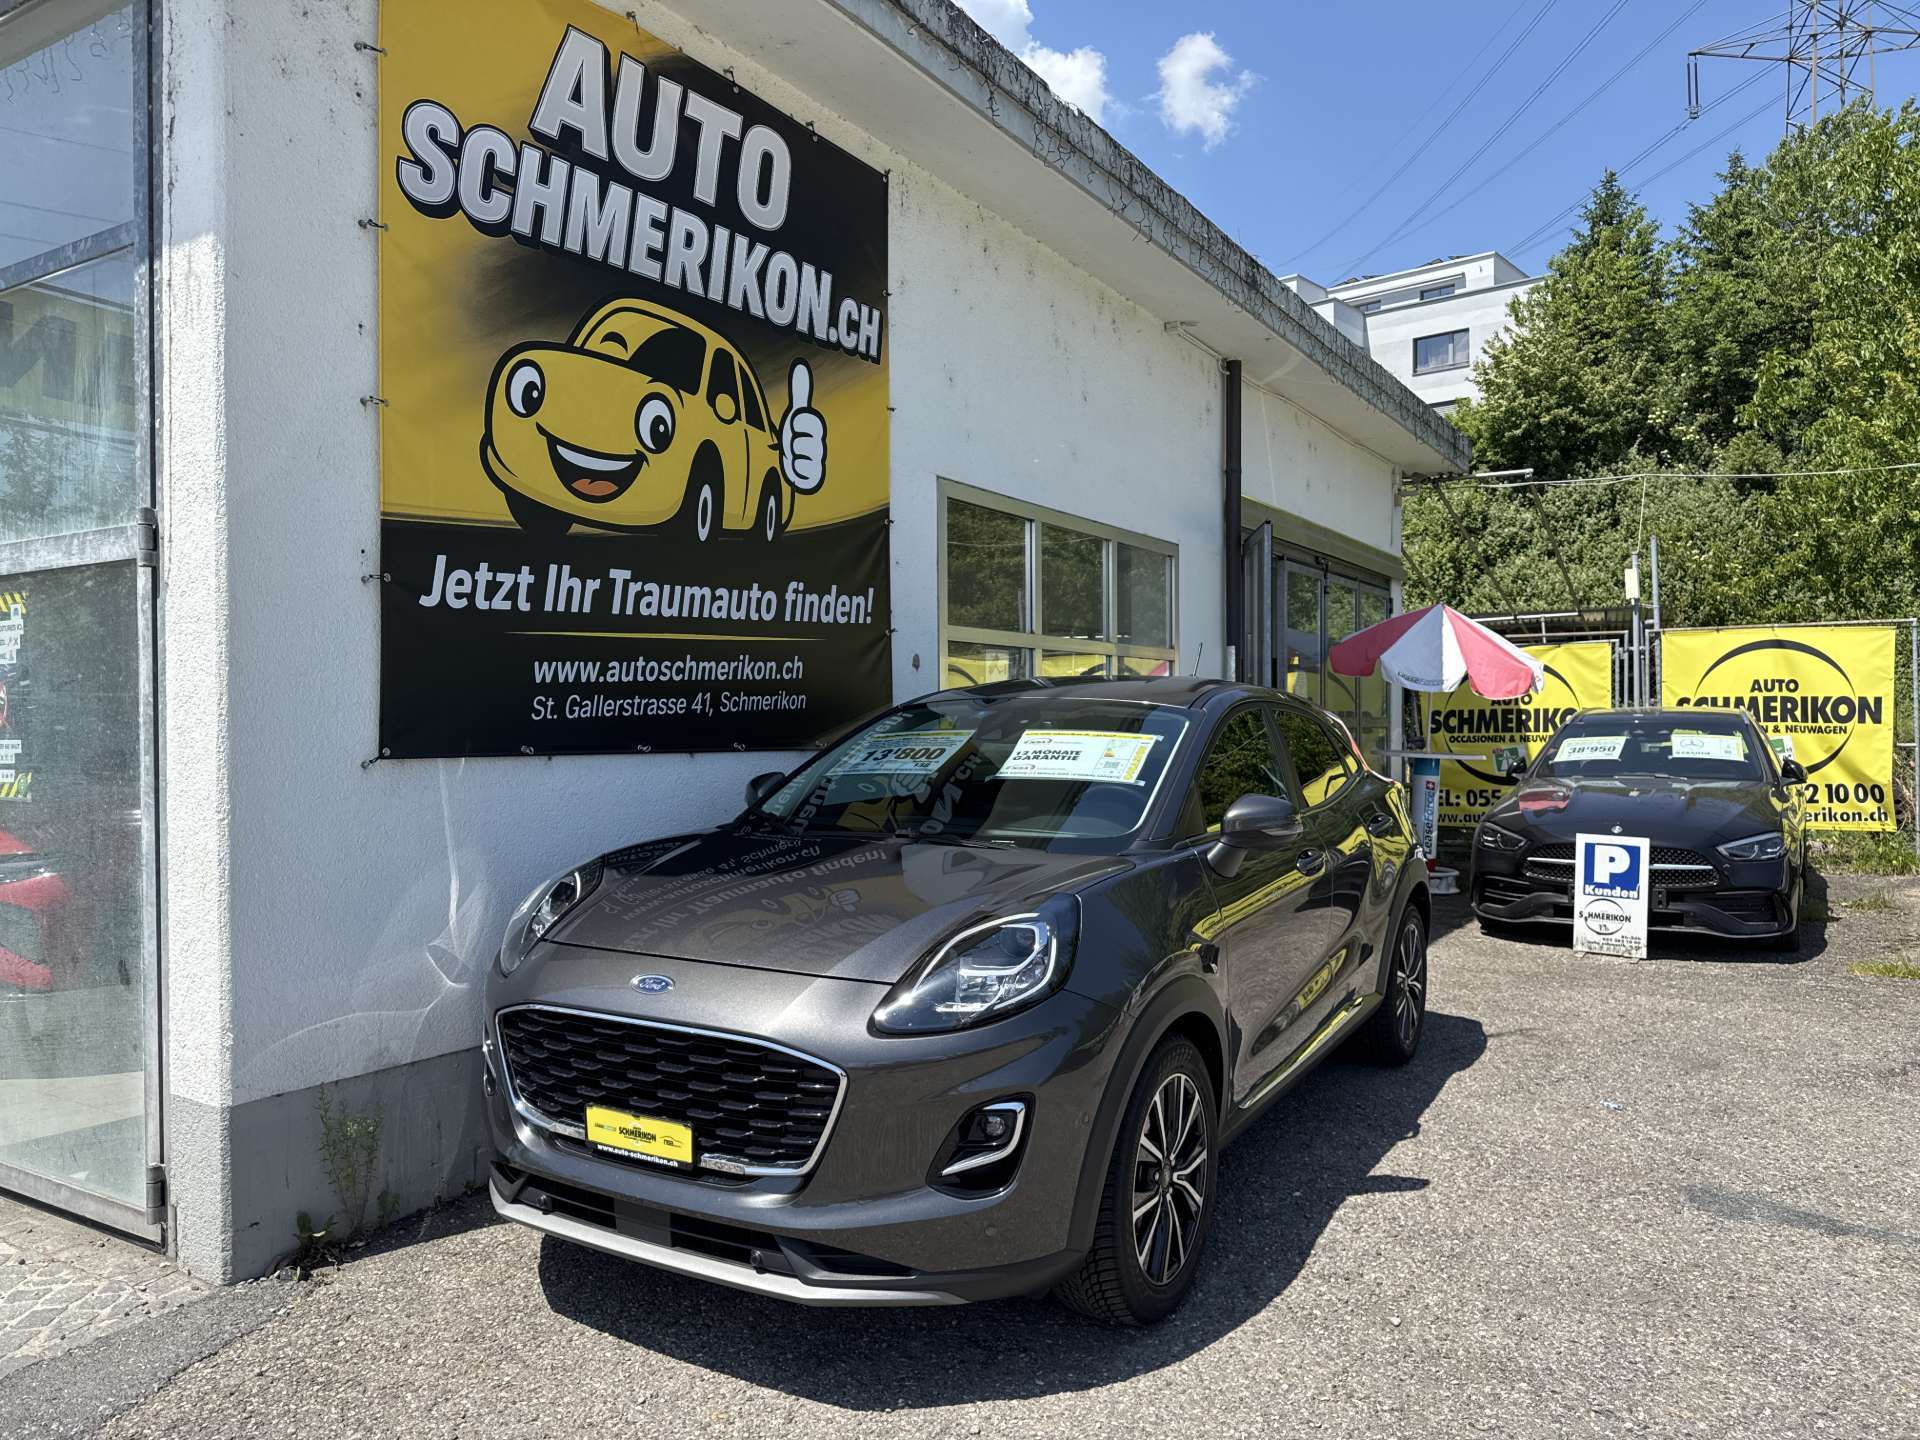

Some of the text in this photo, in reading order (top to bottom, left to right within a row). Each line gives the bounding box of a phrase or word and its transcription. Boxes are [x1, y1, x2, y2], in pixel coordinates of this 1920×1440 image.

[529, 27, 792, 231] AUTO
[398, 101, 882, 361] SCHMERIKON.CH
[418, 554, 873, 624] Jetzt Ihr Traumauto finden!
[533, 654, 804, 684] www.autoschmerikon.ch
[1750, 679, 1800, 693] AUTO
[530, 690, 807, 721] St. Gallerstrasse 41, Schmerikon
[1430, 707, 1578, 734] SCHMERIKO
[1785, 725, 1847, 735] NEUWAGEN
[1449, 735, 1506, 744] OCCASIONEN
[1519, 734, 1550, 743] NEUW
[1804, 783, 1886, 805] 2 10 00
[1805, 807, 1889, 823] erikon.ch
[1593, 844, 1631, 884] P
[1584, 884, 1640, 899] Kunden
[619, 1126, 656, 1142] SCHMERIKON
[597, 1144, 679, 1168] www.auto-schmerikon.ch
